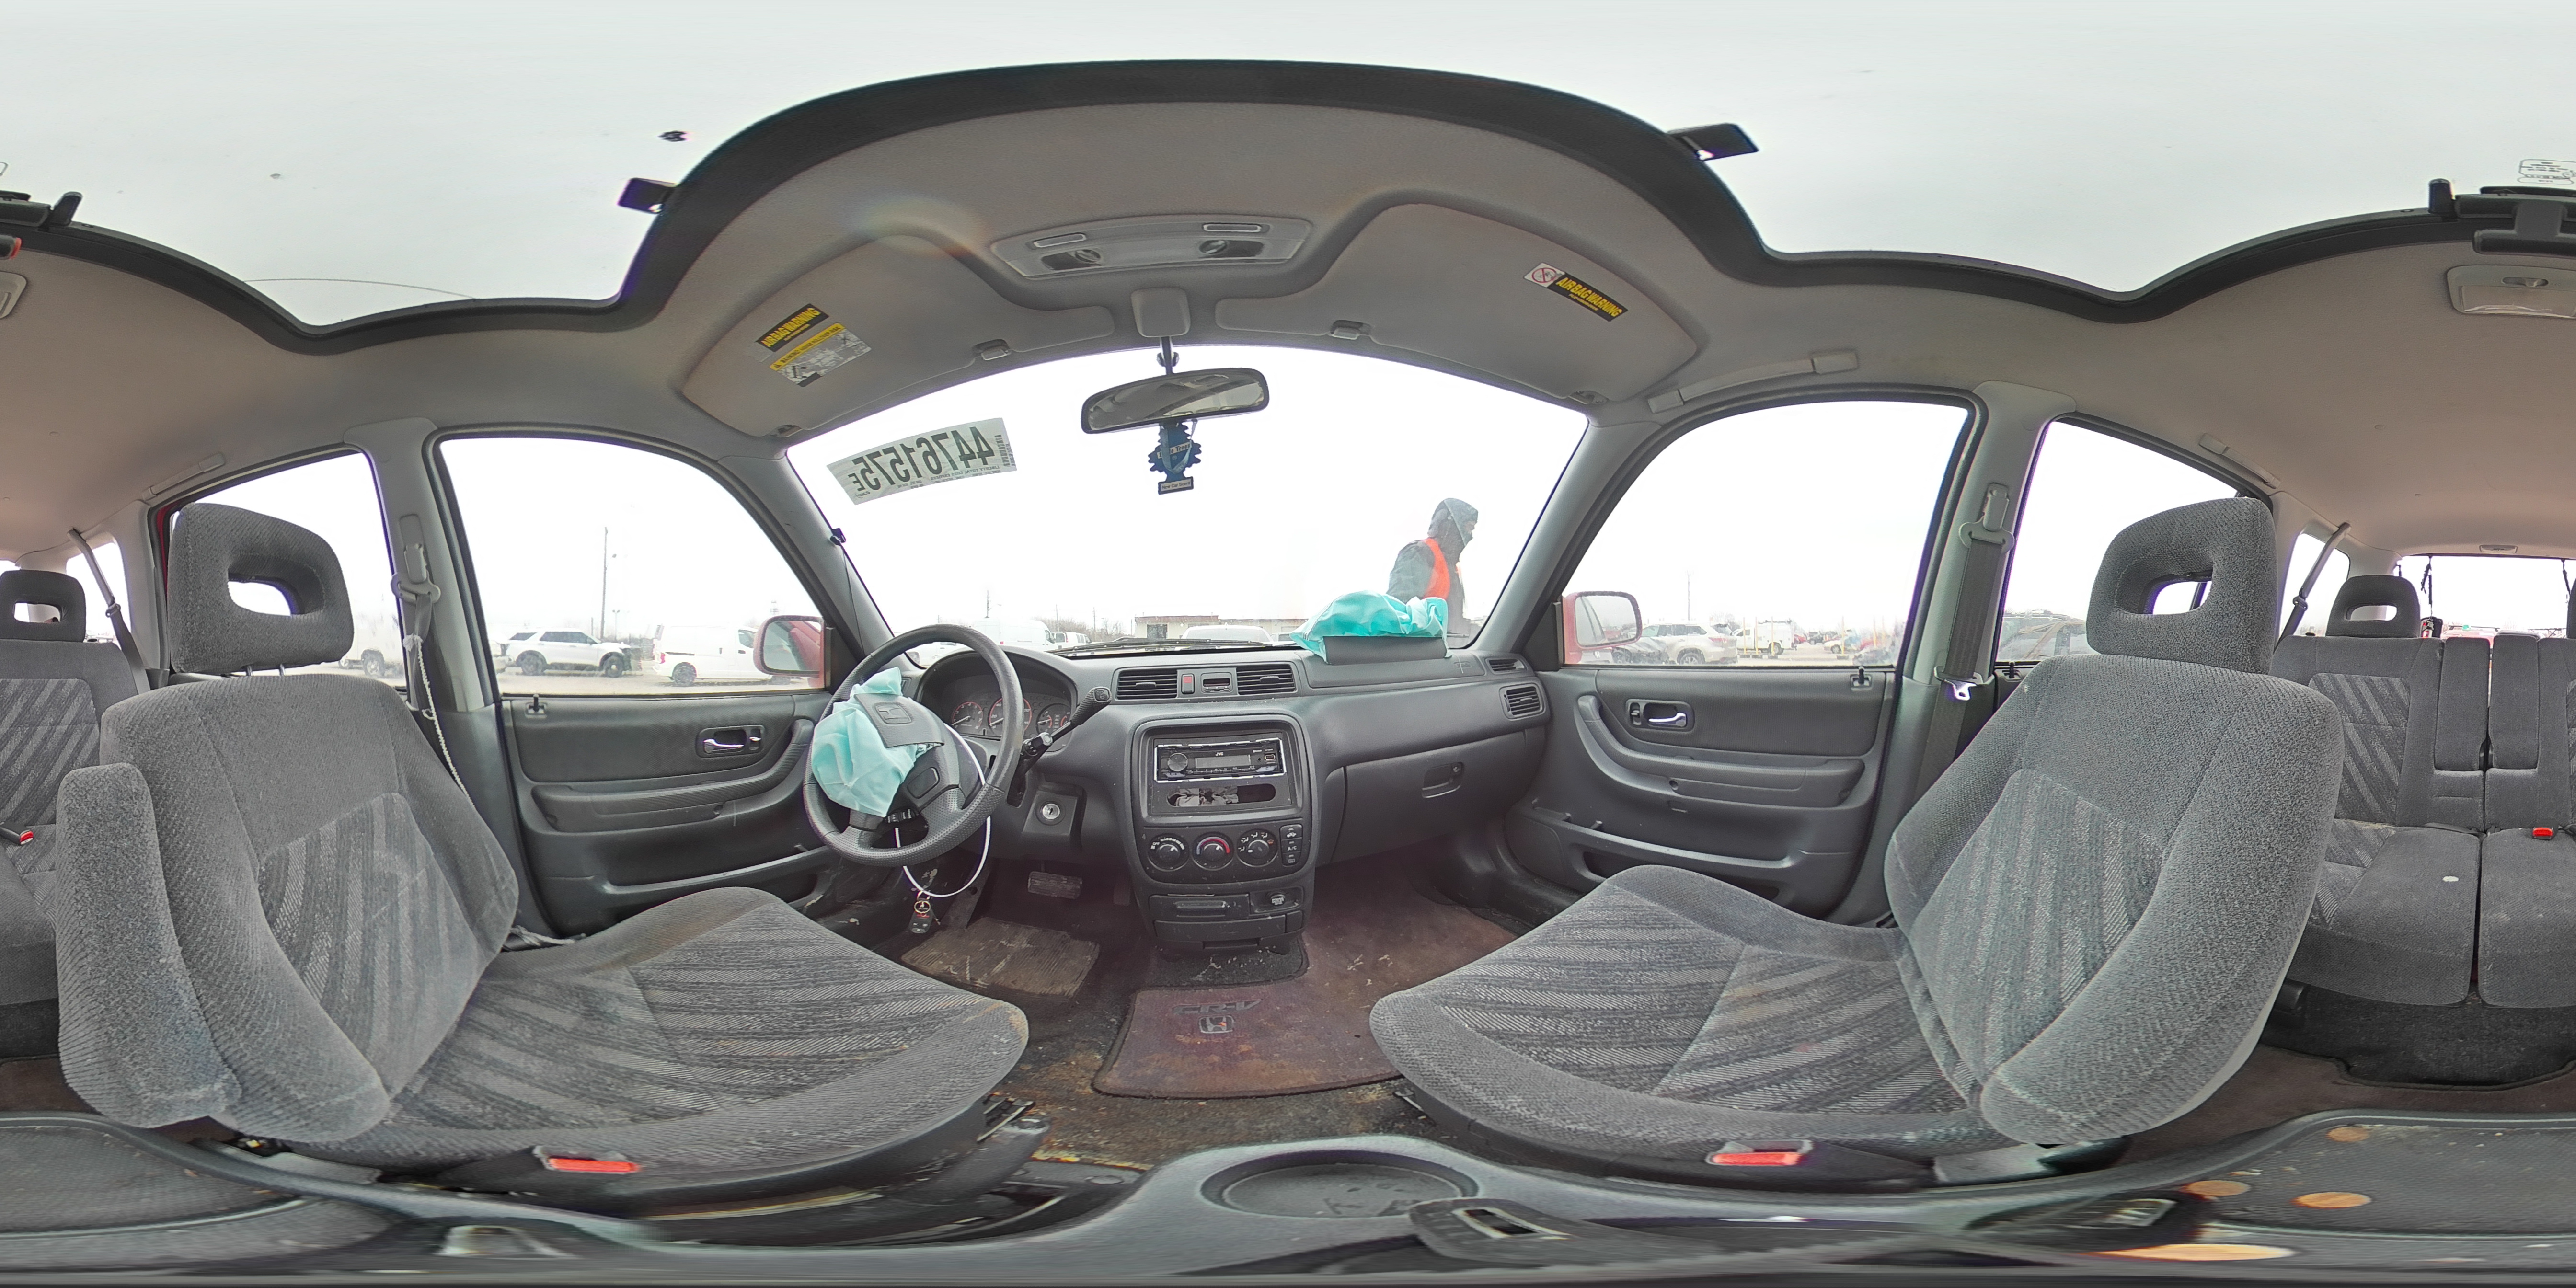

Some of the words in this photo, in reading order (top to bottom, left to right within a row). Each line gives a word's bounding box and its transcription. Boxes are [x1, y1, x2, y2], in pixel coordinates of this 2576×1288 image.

[1555, 277, 1592, 299] AIRBAG
[1587, 292, 1622, 317] WARNING
[761, 326, 791, 347] AIRBAG
[785, 308, 821, 332] WARNING
[1172, 999, 1263, 1015] CR-V
